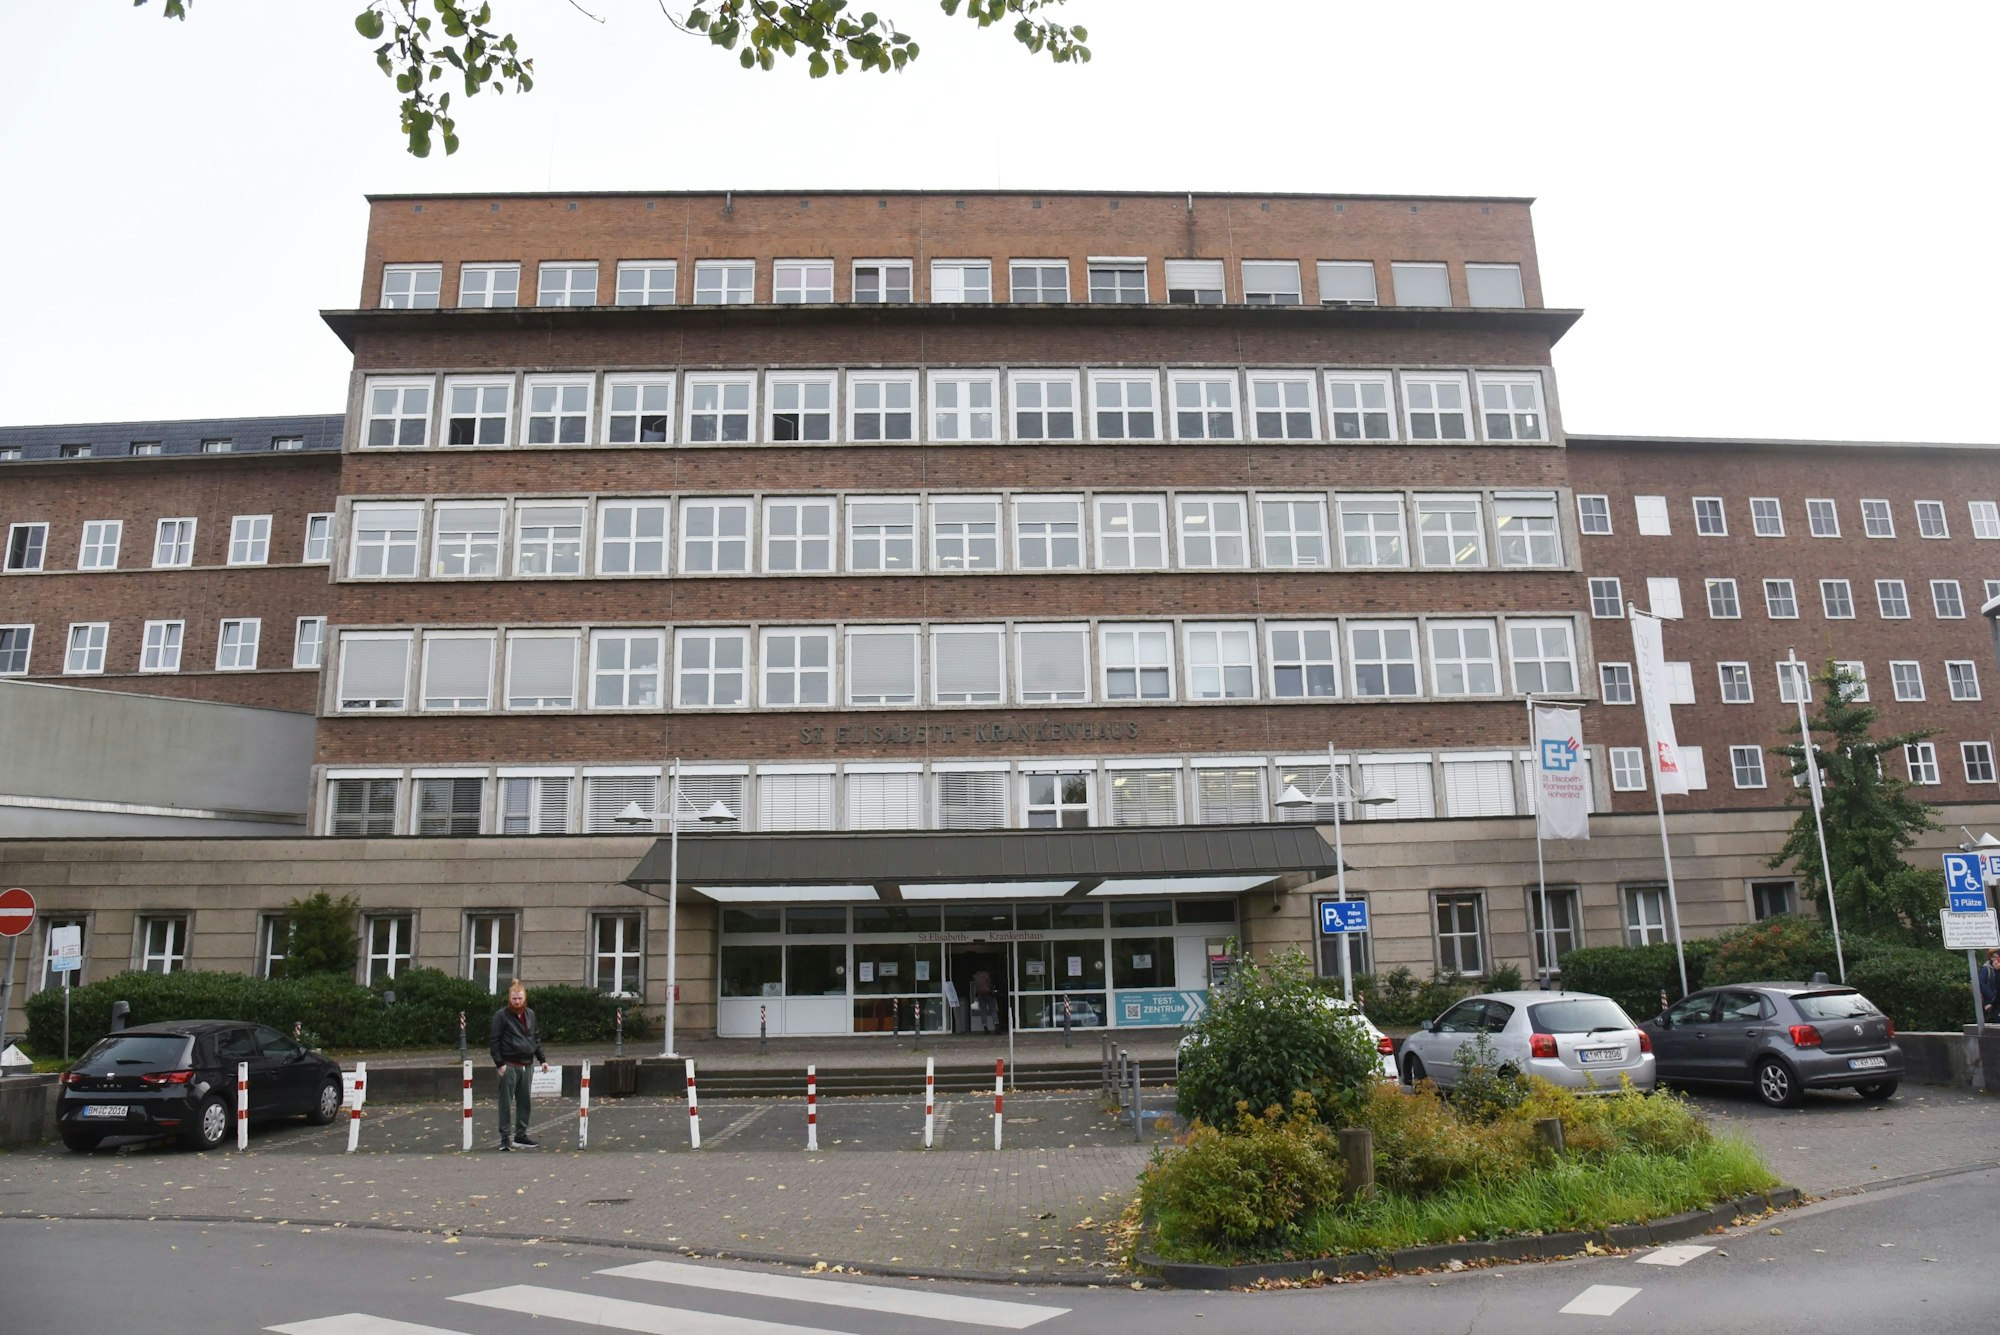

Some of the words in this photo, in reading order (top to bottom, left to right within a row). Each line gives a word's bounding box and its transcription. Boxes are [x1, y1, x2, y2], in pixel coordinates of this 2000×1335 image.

[1543, 783, 1584, 791] Krankenhaus
[1946, 857, 1968, 887] P
[1954, 899, 1959, 907] 3
[1960, 899, 1982, 907] Plätze
[1325, 908, 1337, 925] P
[989, 930, 1044, 941] Krankenhaus
[1152, 996, 1175, 1005] TEST-
[1143, 1005, 1184, 1014] ZENTRUM
